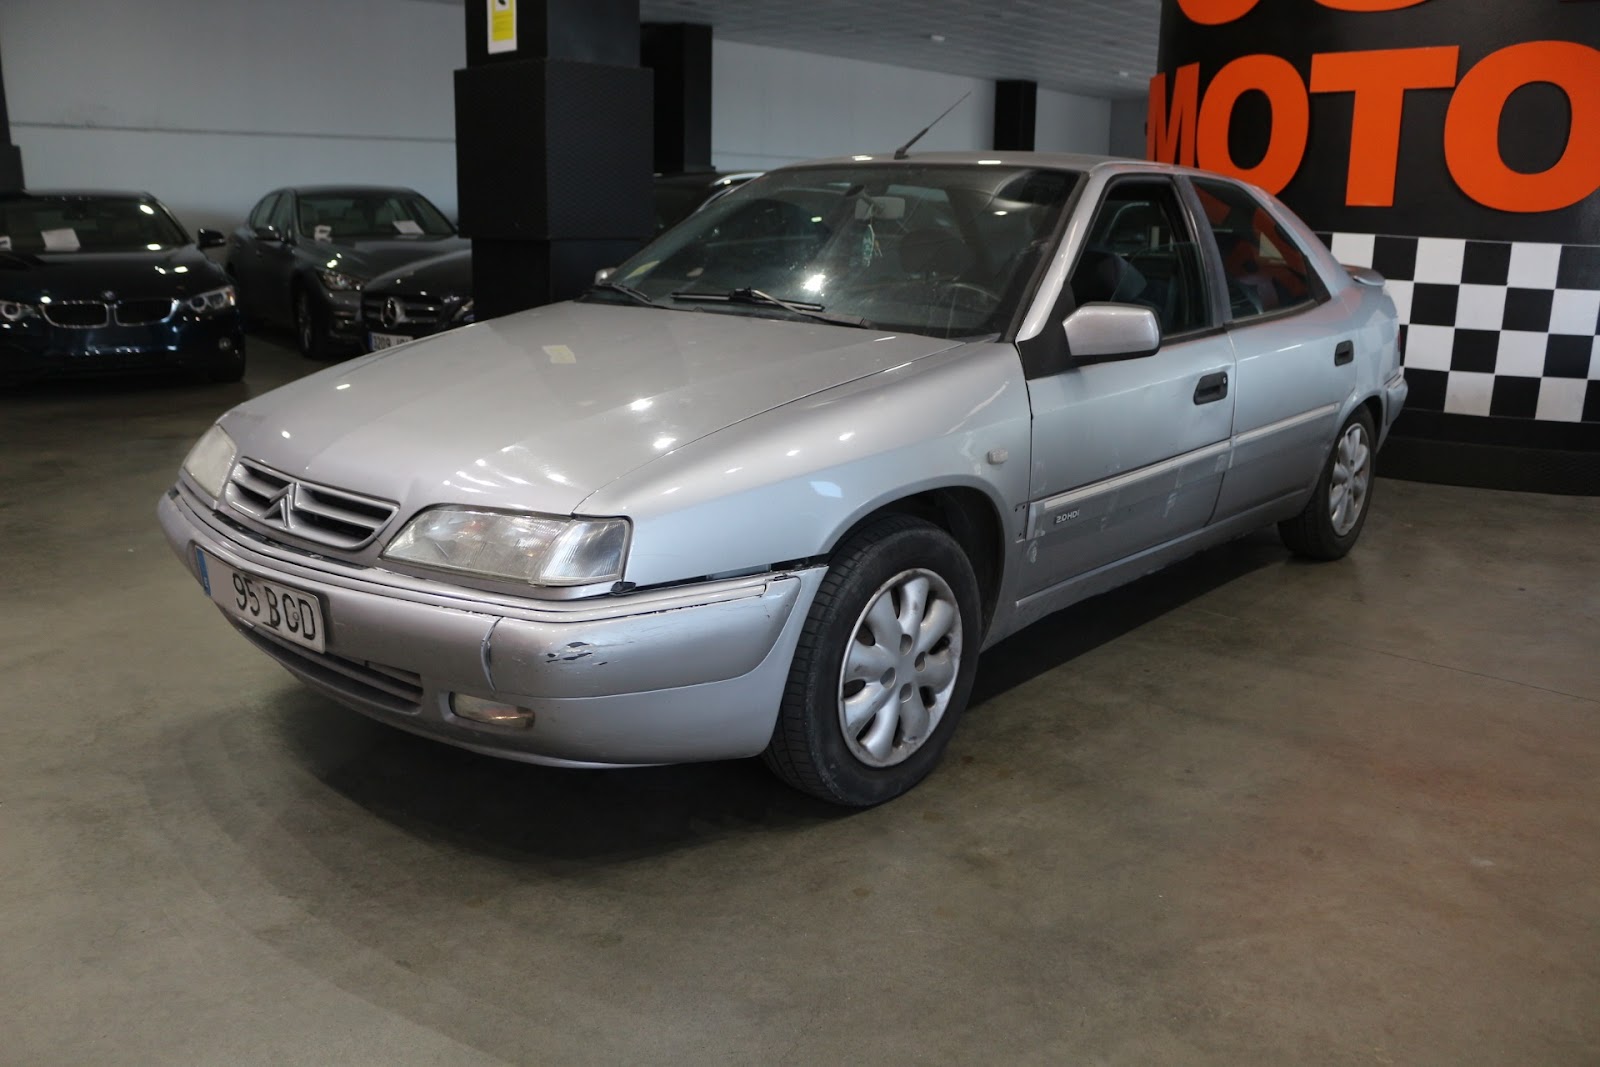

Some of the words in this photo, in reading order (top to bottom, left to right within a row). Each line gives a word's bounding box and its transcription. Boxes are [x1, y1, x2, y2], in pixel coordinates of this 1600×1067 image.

[1147, 40, 1600, 213] MOTO
[232, 573, 260, 616] 95
[263, 586, 316, 640] BCD
